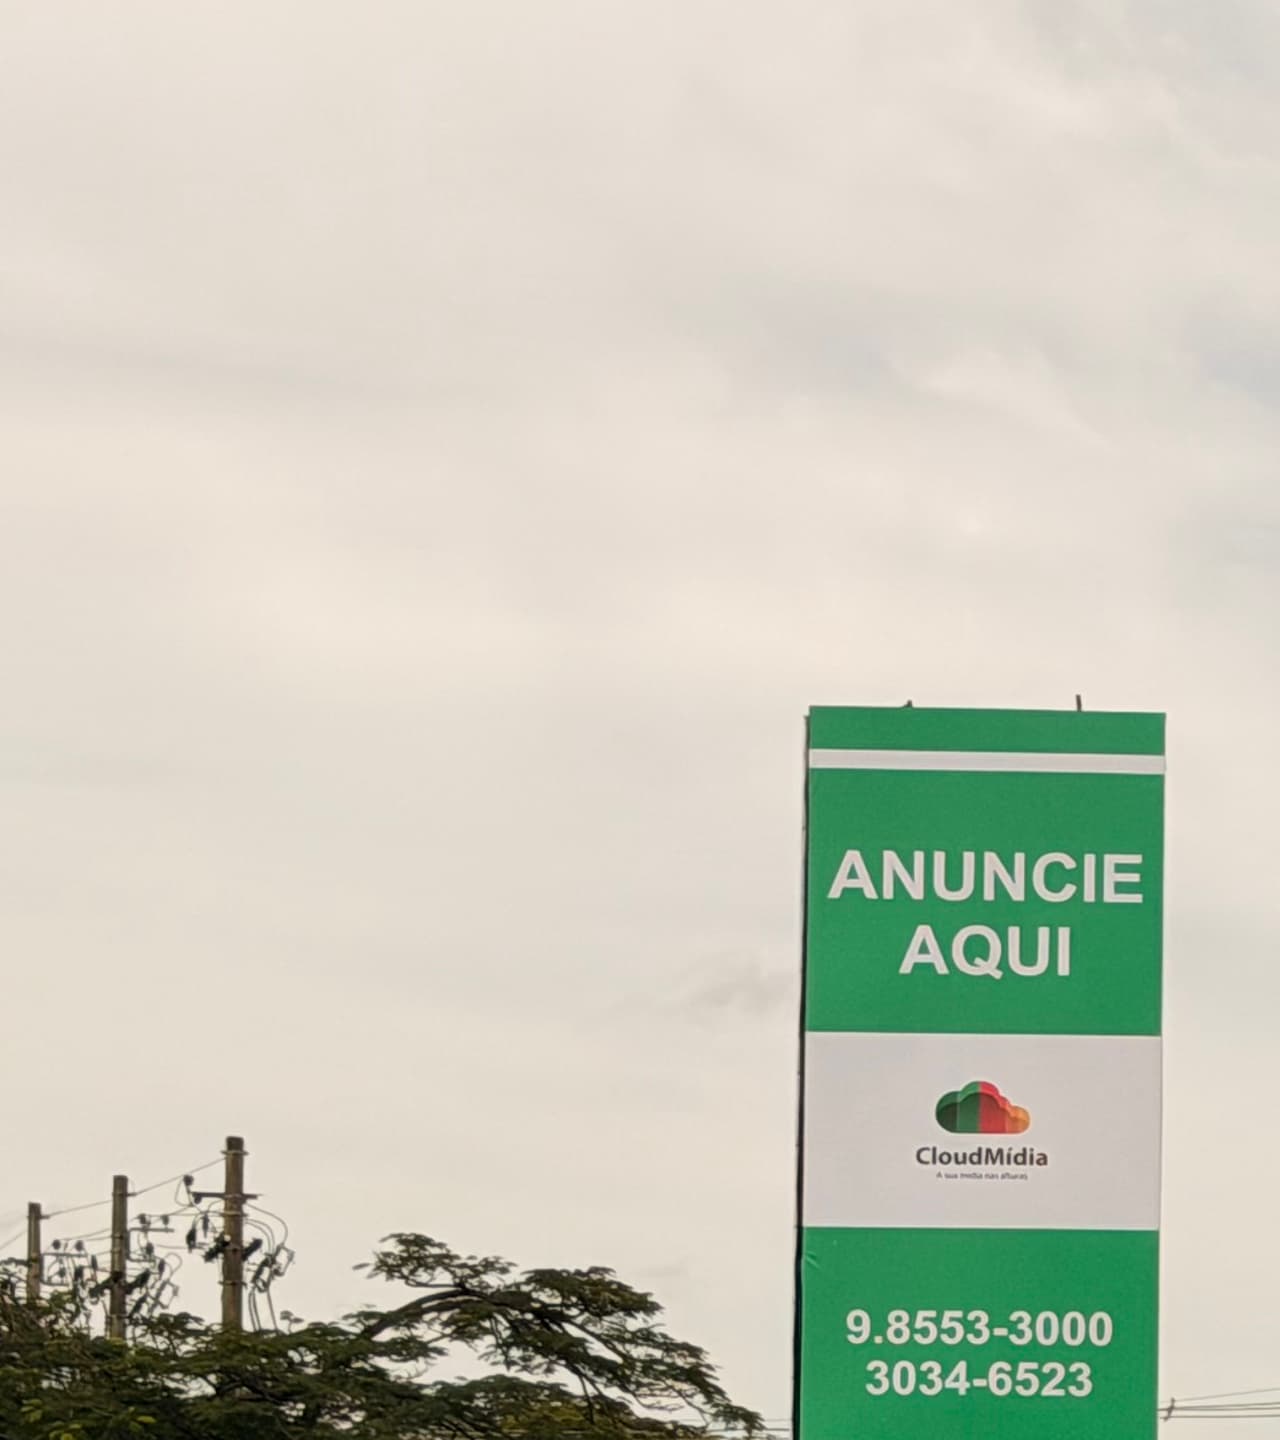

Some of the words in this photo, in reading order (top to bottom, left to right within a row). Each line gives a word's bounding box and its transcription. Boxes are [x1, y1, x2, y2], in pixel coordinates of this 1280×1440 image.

[827, 849, 1144, 904] ANUNCIE
[899, 924, 1072, 980] AQUI
[915, 1146, 1049, 1167] CloudMídia
[846, 1309, 1113, 1347] 9.8553-3000
[865, 1360, 1093, 1397] 3034-6523
